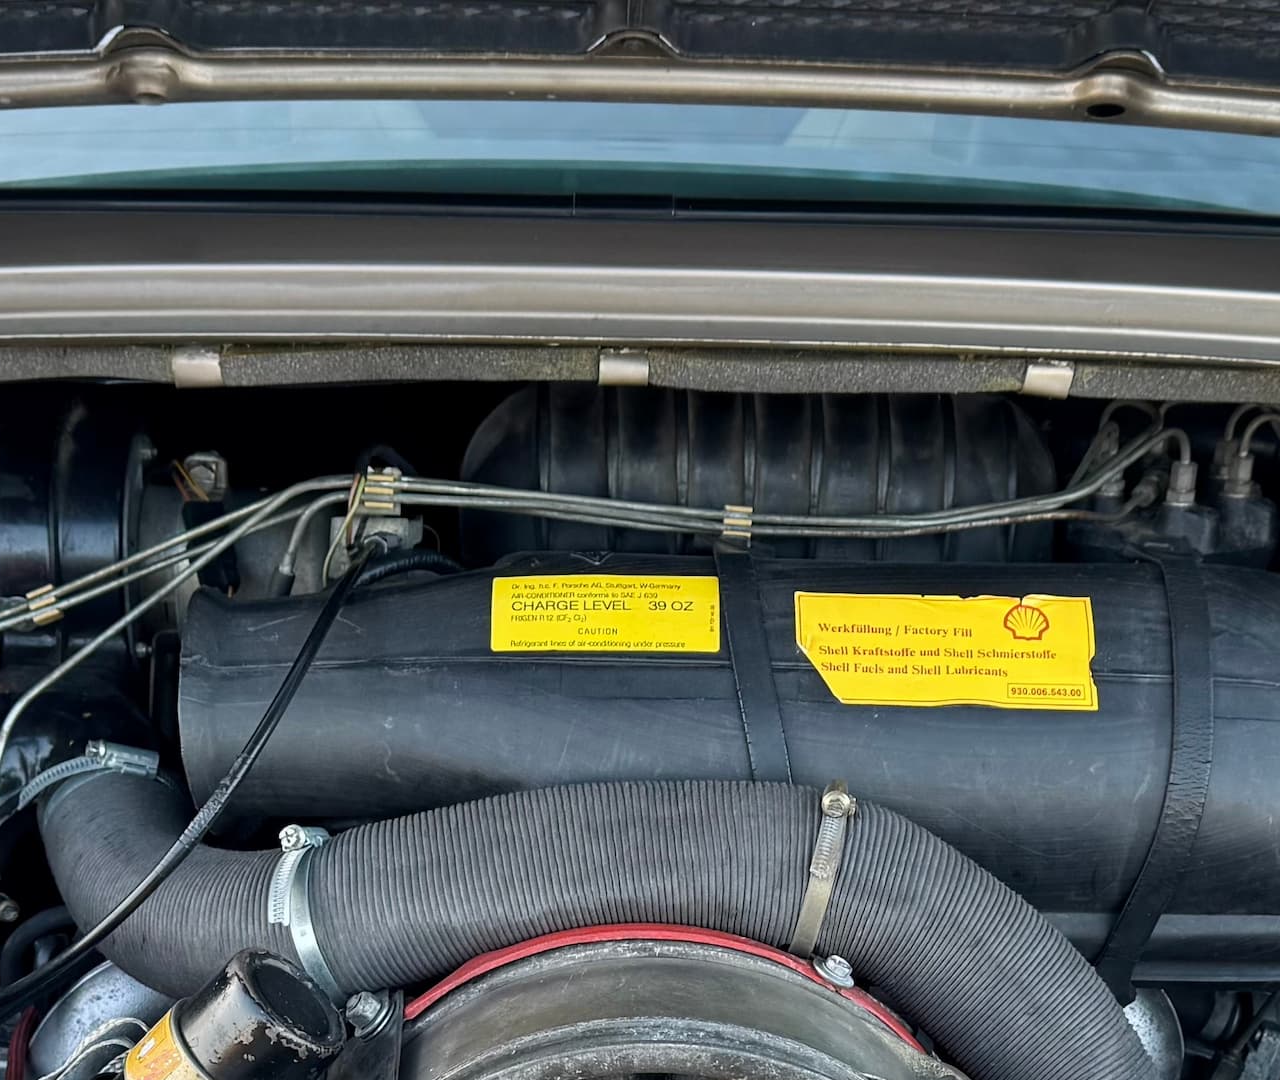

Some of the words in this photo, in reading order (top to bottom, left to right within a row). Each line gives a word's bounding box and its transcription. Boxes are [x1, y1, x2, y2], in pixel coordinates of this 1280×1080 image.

[511, 600, 579, 611] CHARGE
[583, 600, 632, 611] LEVEL
[648, 601, 666, 611] 39
[671, 601, 694, 611] OZ
[577, 627, 618, 635] CAUTION
[818, 623, 892, 636] Werkfüllung
[904, 625, 949, 638] Factory
[953, 627, 972, 638] Fill
[510, 640, 548, 648] Refrigerant
[577, 640, 631, 648] air-conditioning
[819, 645, 848, 656] Shell
[852, 646, 916, 657] Kraftstoffe
[920, 648, 940, 657] und
[943, 647, 973, 659] Shell
[977, 648, 1057, 660] Schmierstoffe
[821, 661, 850, 672] Shell
[854, 663, 884, 674] Fuels
[887, 665, 908, 674] and
[912, 665, 941, 675] Shell
[946, 665, 1008, 677] Lubricants
